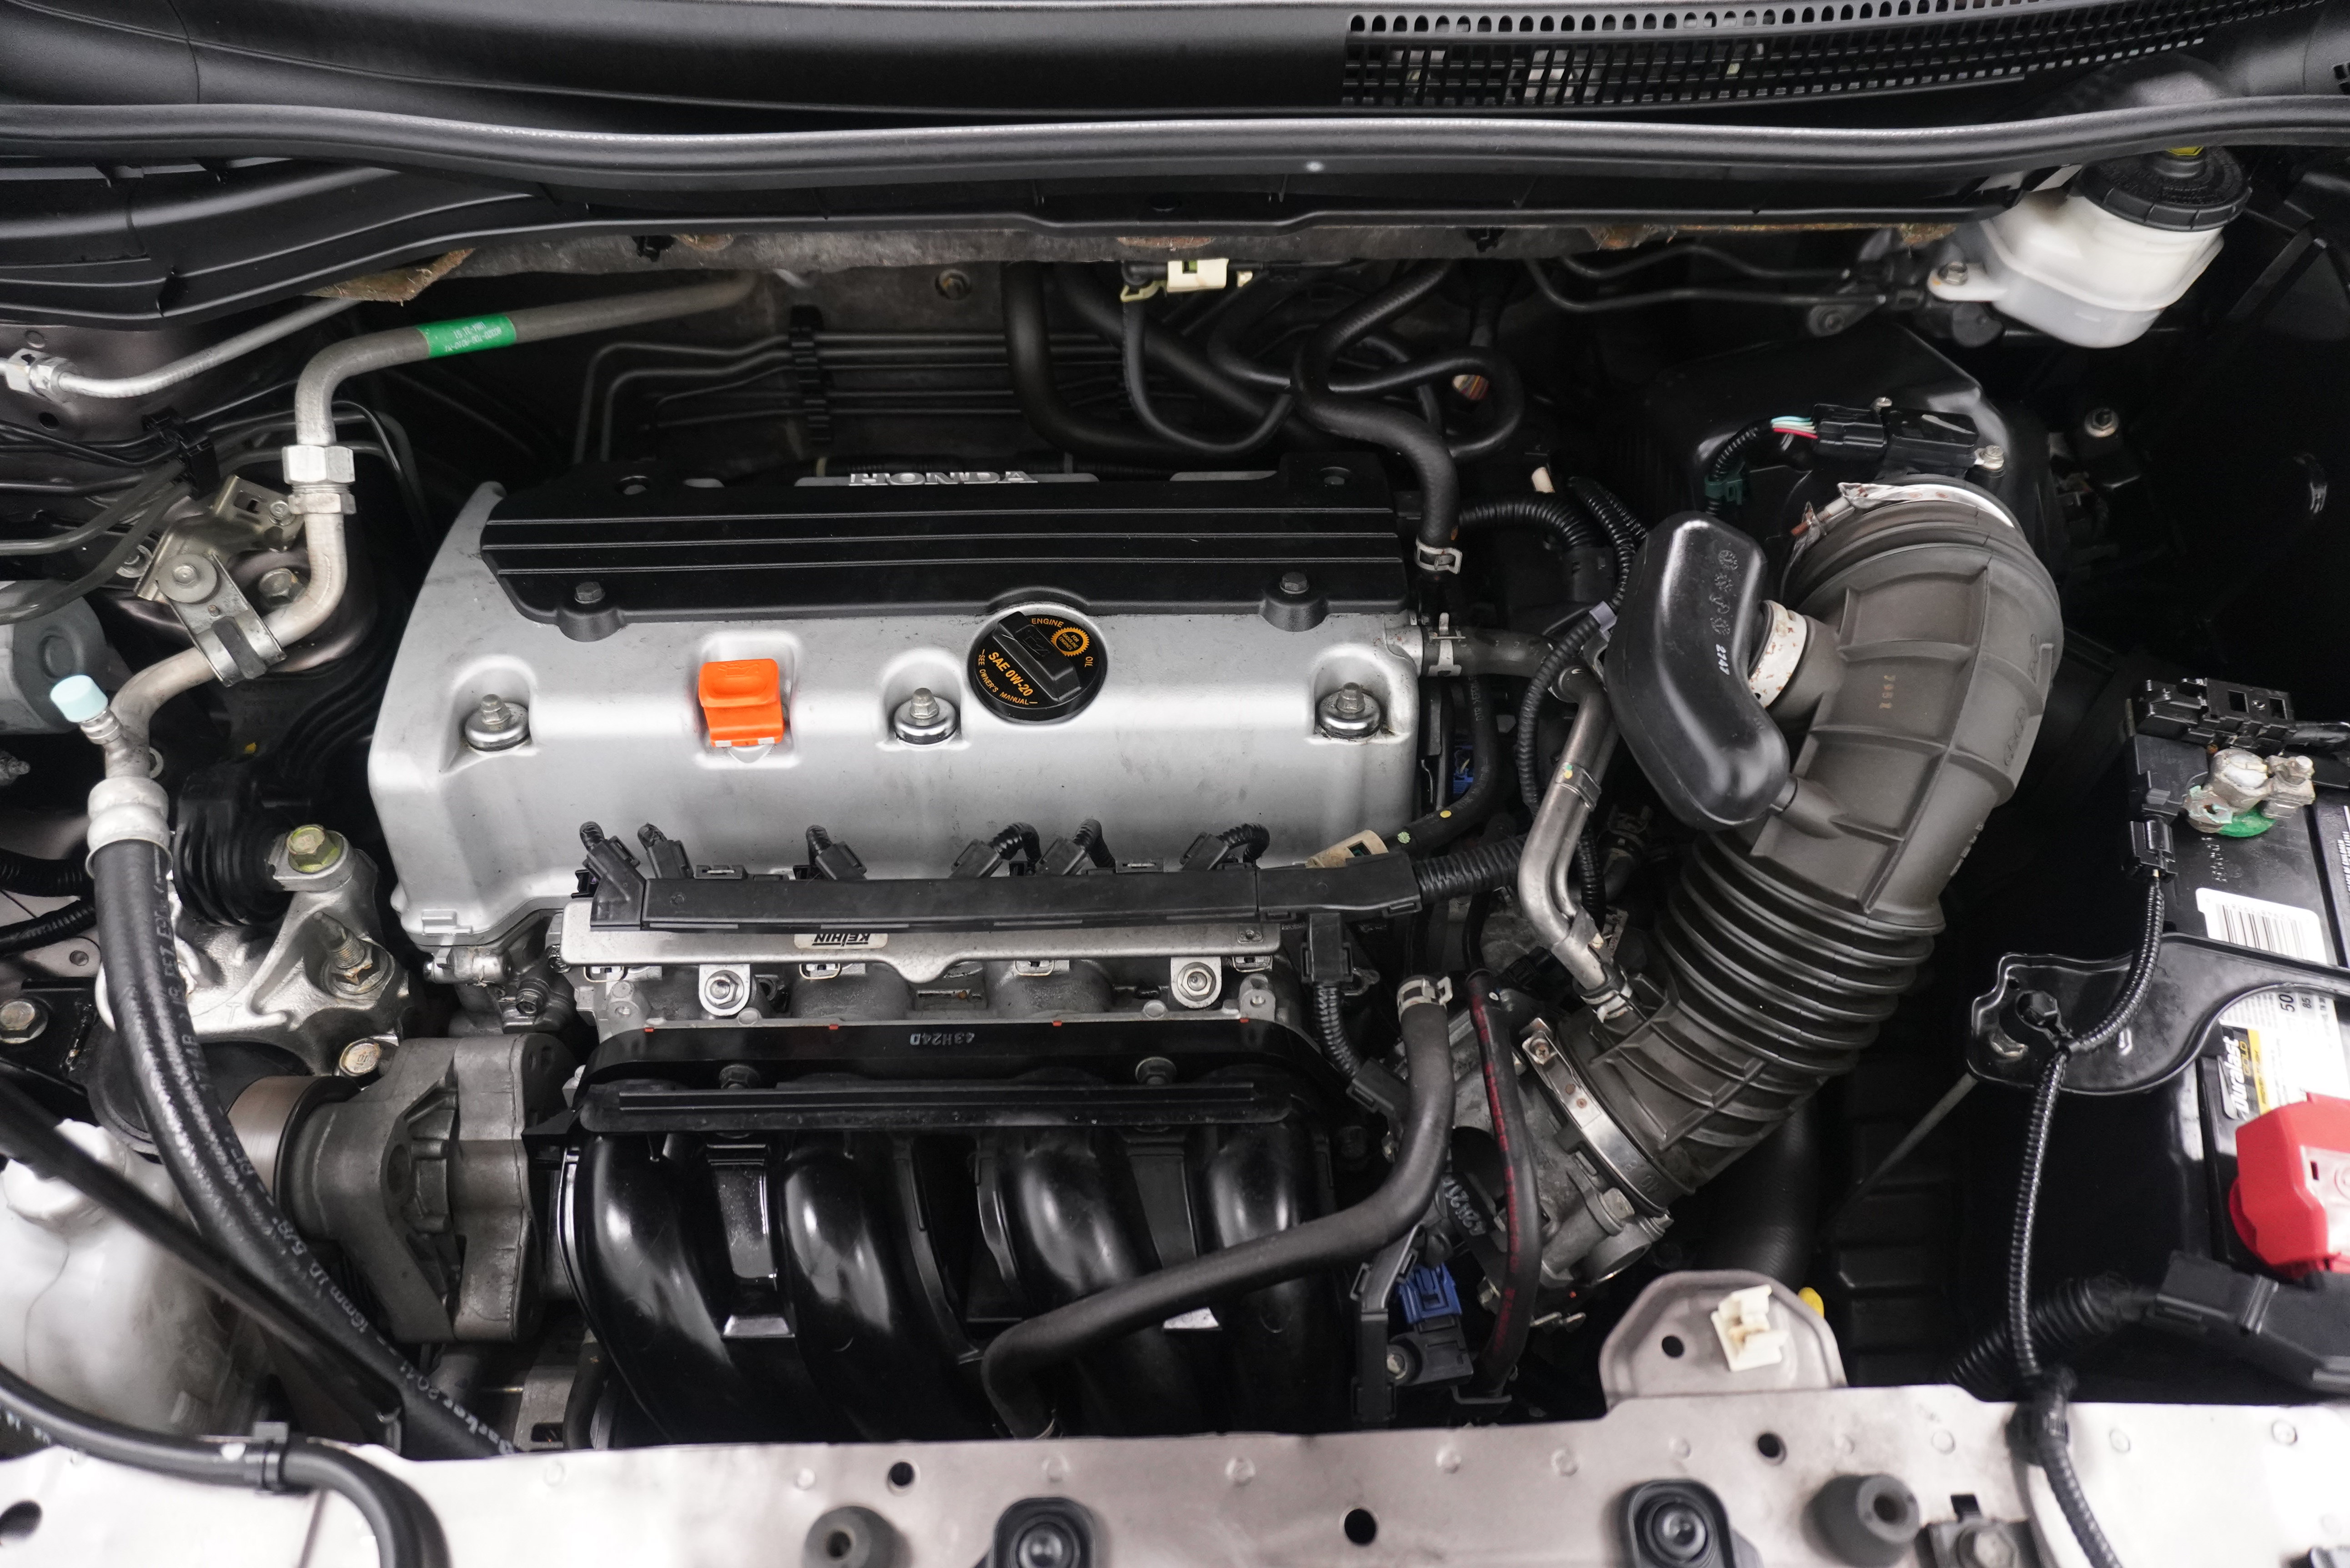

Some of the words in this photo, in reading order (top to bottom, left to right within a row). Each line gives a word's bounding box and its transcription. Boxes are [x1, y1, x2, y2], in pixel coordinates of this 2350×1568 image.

[849, 471, 1038, 486] HONDA
[1031, 618, 1064, 628] ENGINE
[1085, 656, 1093, 668] OIL
[1058, 636, 1073, 651] ENGINES
[1062, 633, 1079, 648] GASOLINE
[1071, 634, 1080, 643] FOR
[979, 668, 999, 693] OWNER'S
[988, 652, 1010, 672] SAE
[1005, 669, 1033, 697] 0W-20
[812, 933, 871, 945] KEIHIN
[2240, 1040, 2251, 1076] GOLD
[2222, 1035, 2250, 1115] Duralast
